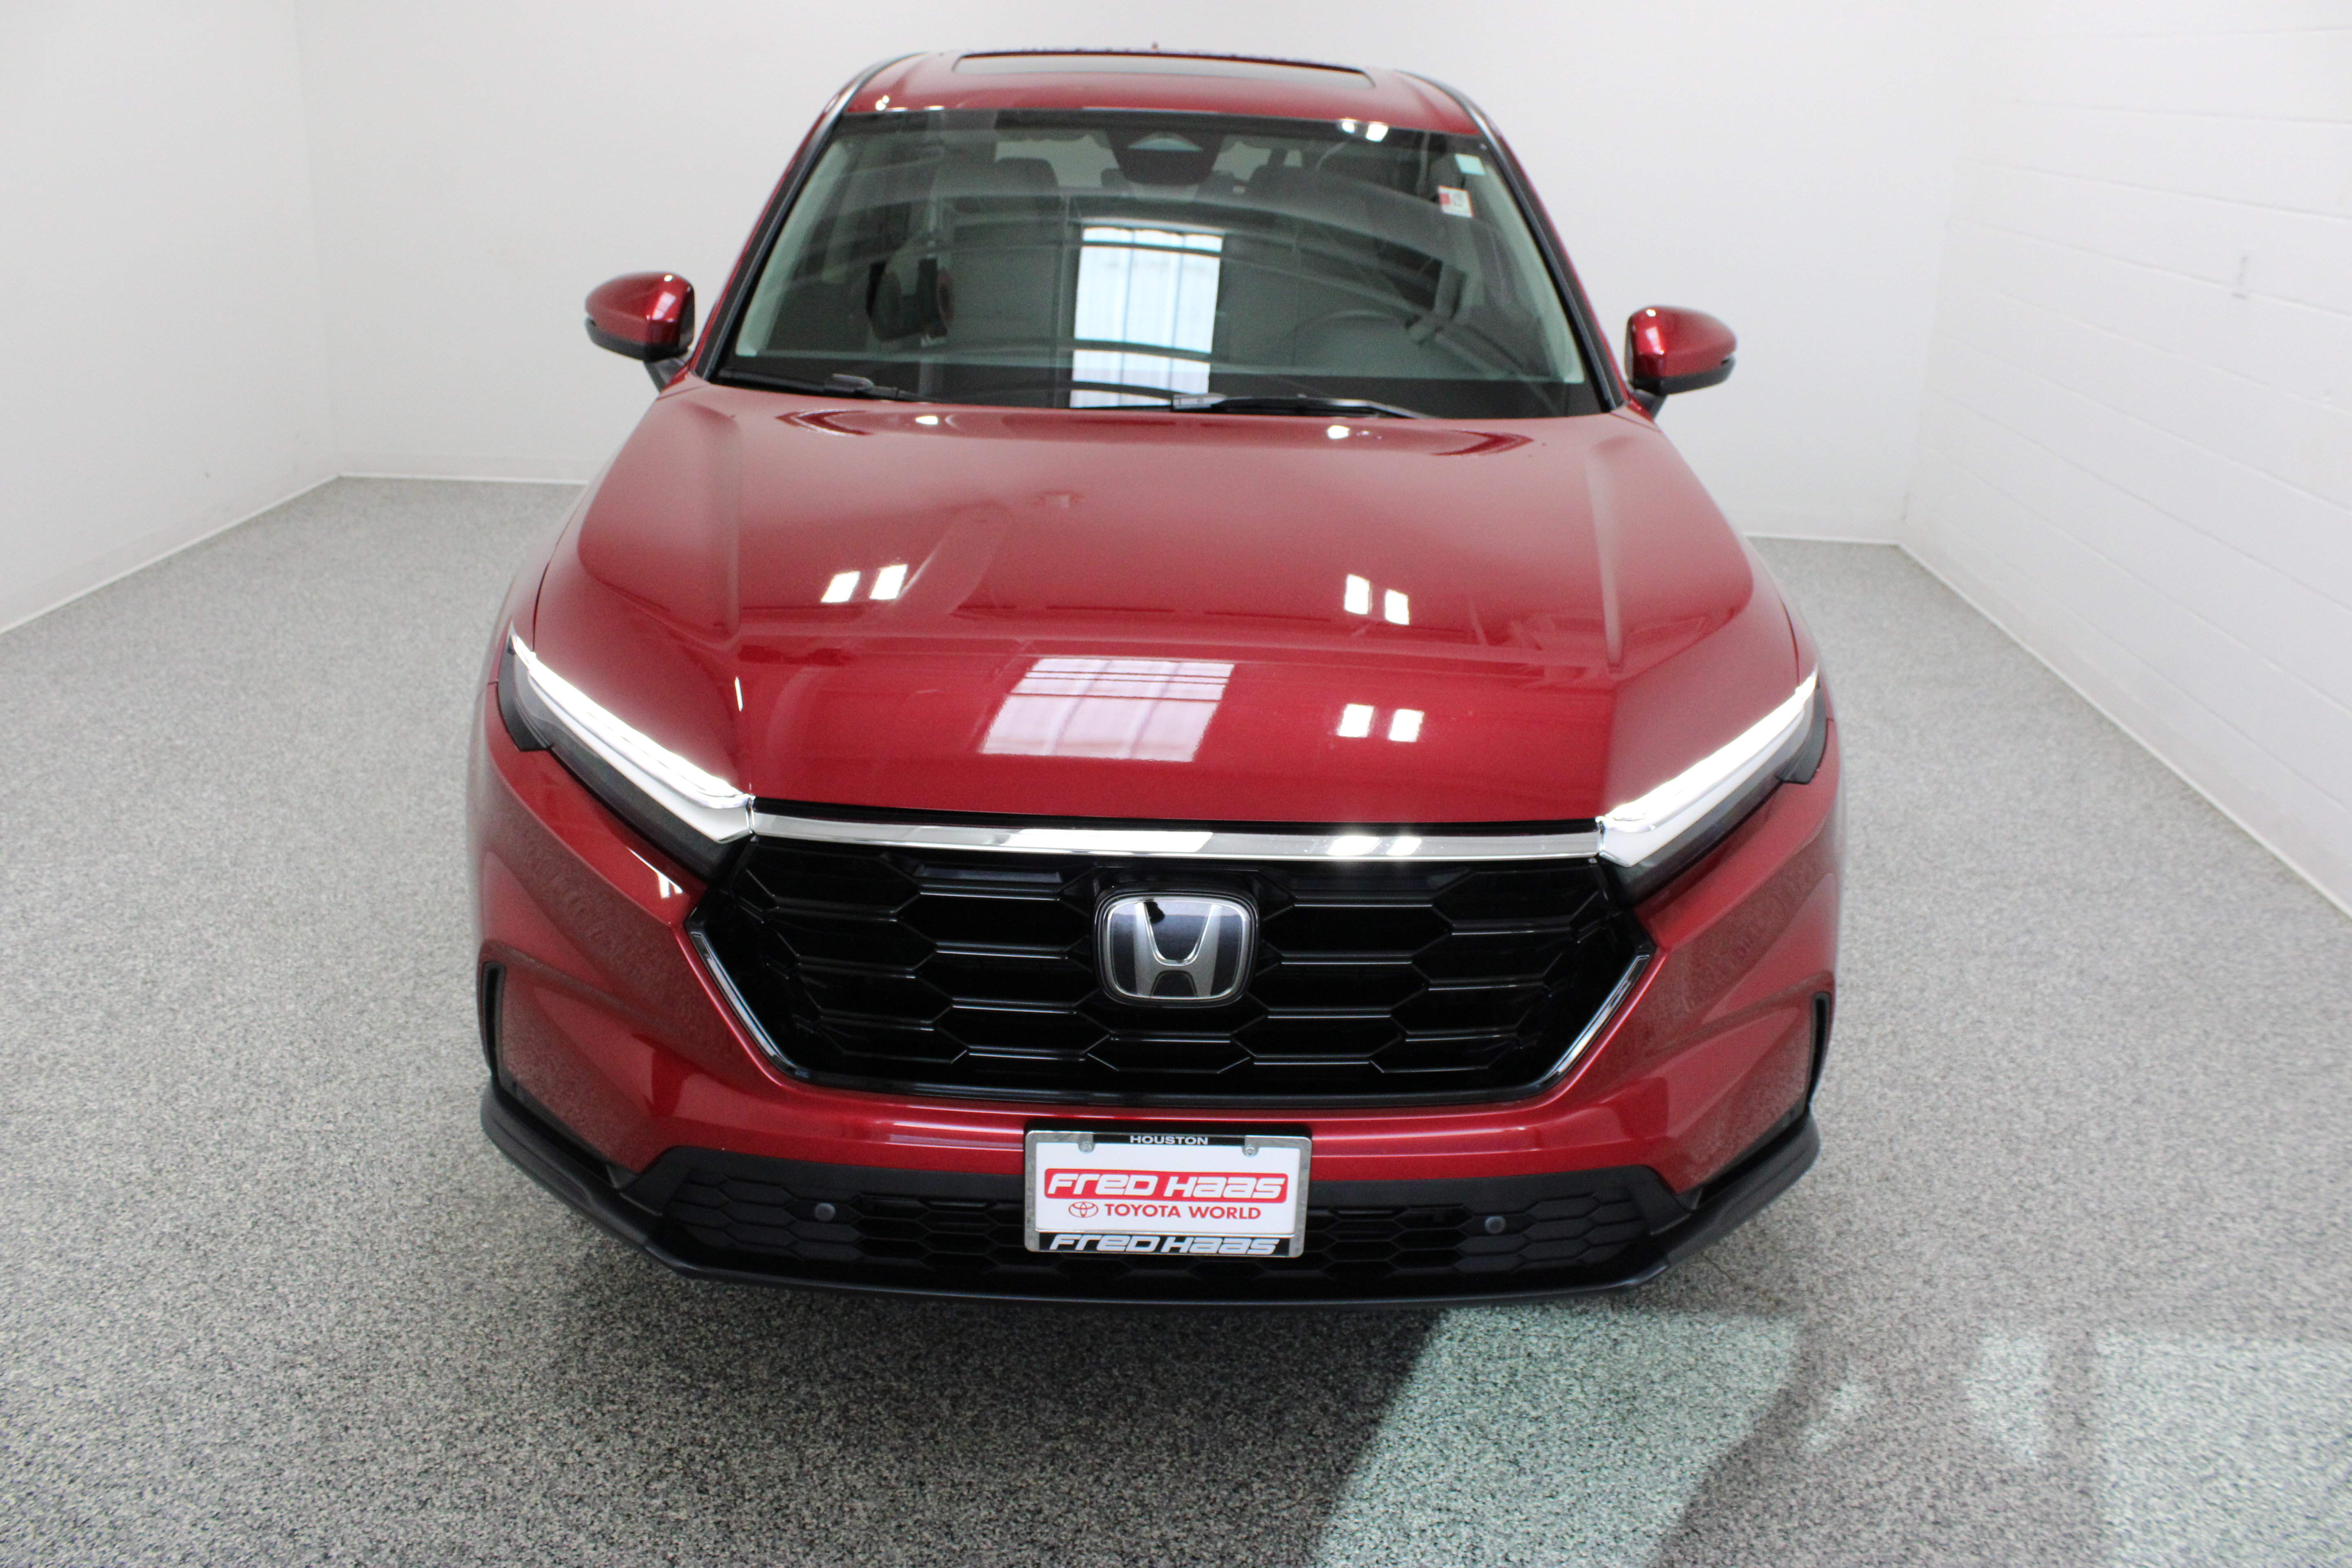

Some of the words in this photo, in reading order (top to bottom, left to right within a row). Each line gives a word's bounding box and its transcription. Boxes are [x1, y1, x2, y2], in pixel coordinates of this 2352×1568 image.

[1130, 1136, 1208, 1145] HOUSTON
[1105, 1204, 1181, 1218] TOYOTA
[1189, 1206, 1261, 1220] WORLD
